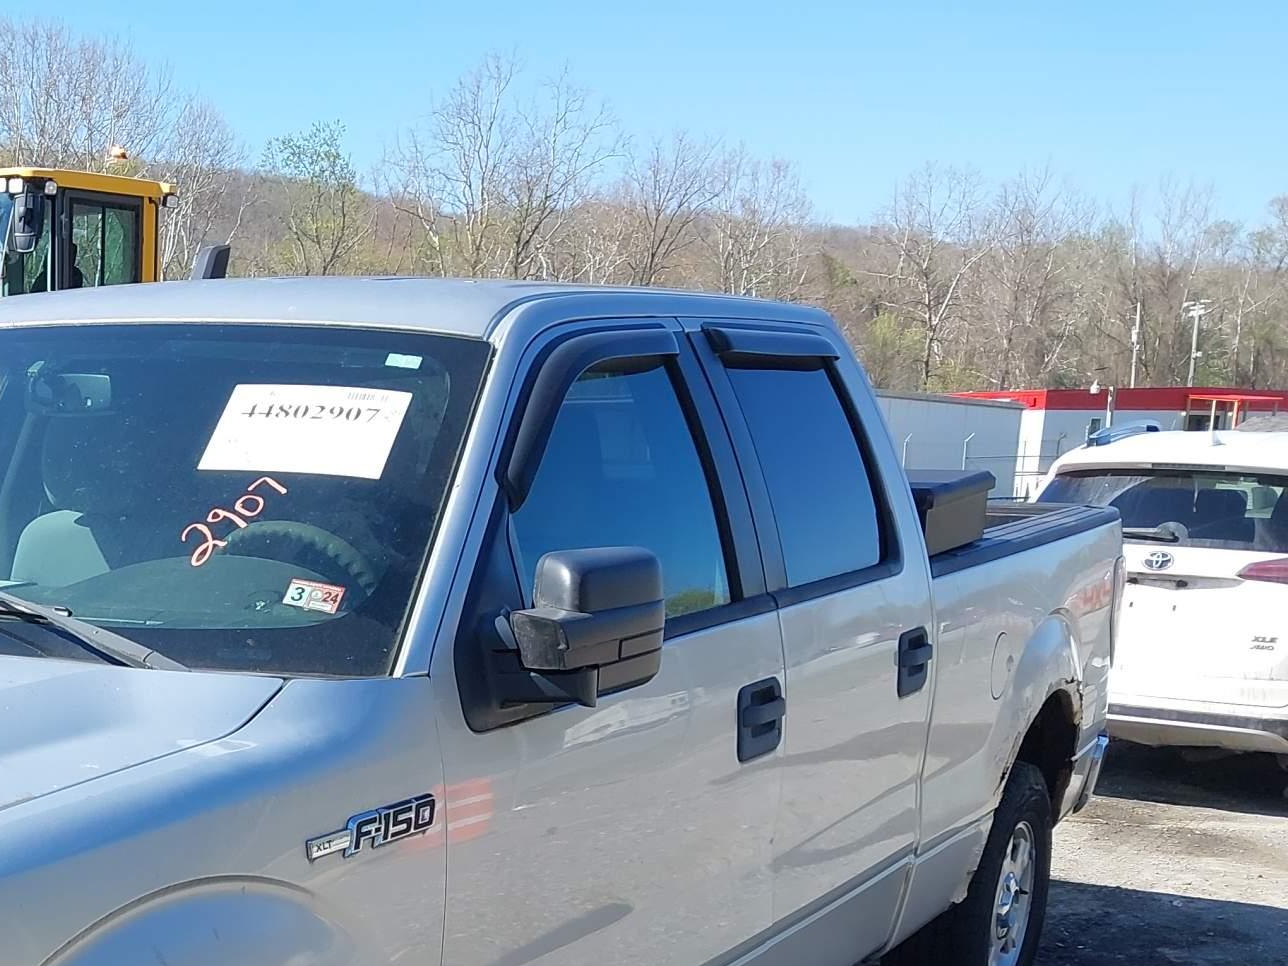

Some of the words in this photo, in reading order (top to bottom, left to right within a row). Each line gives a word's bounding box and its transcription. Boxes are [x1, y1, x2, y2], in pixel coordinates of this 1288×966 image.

[241, 403, 381, 423] 44802907
[181, 476, 288, 567] 2907
[290, 586, 306, 602] 3
[321, 591, 340, 605] 24
[314, 839, 333, 853] XLT
[353, 798, 436, 851] F-150
